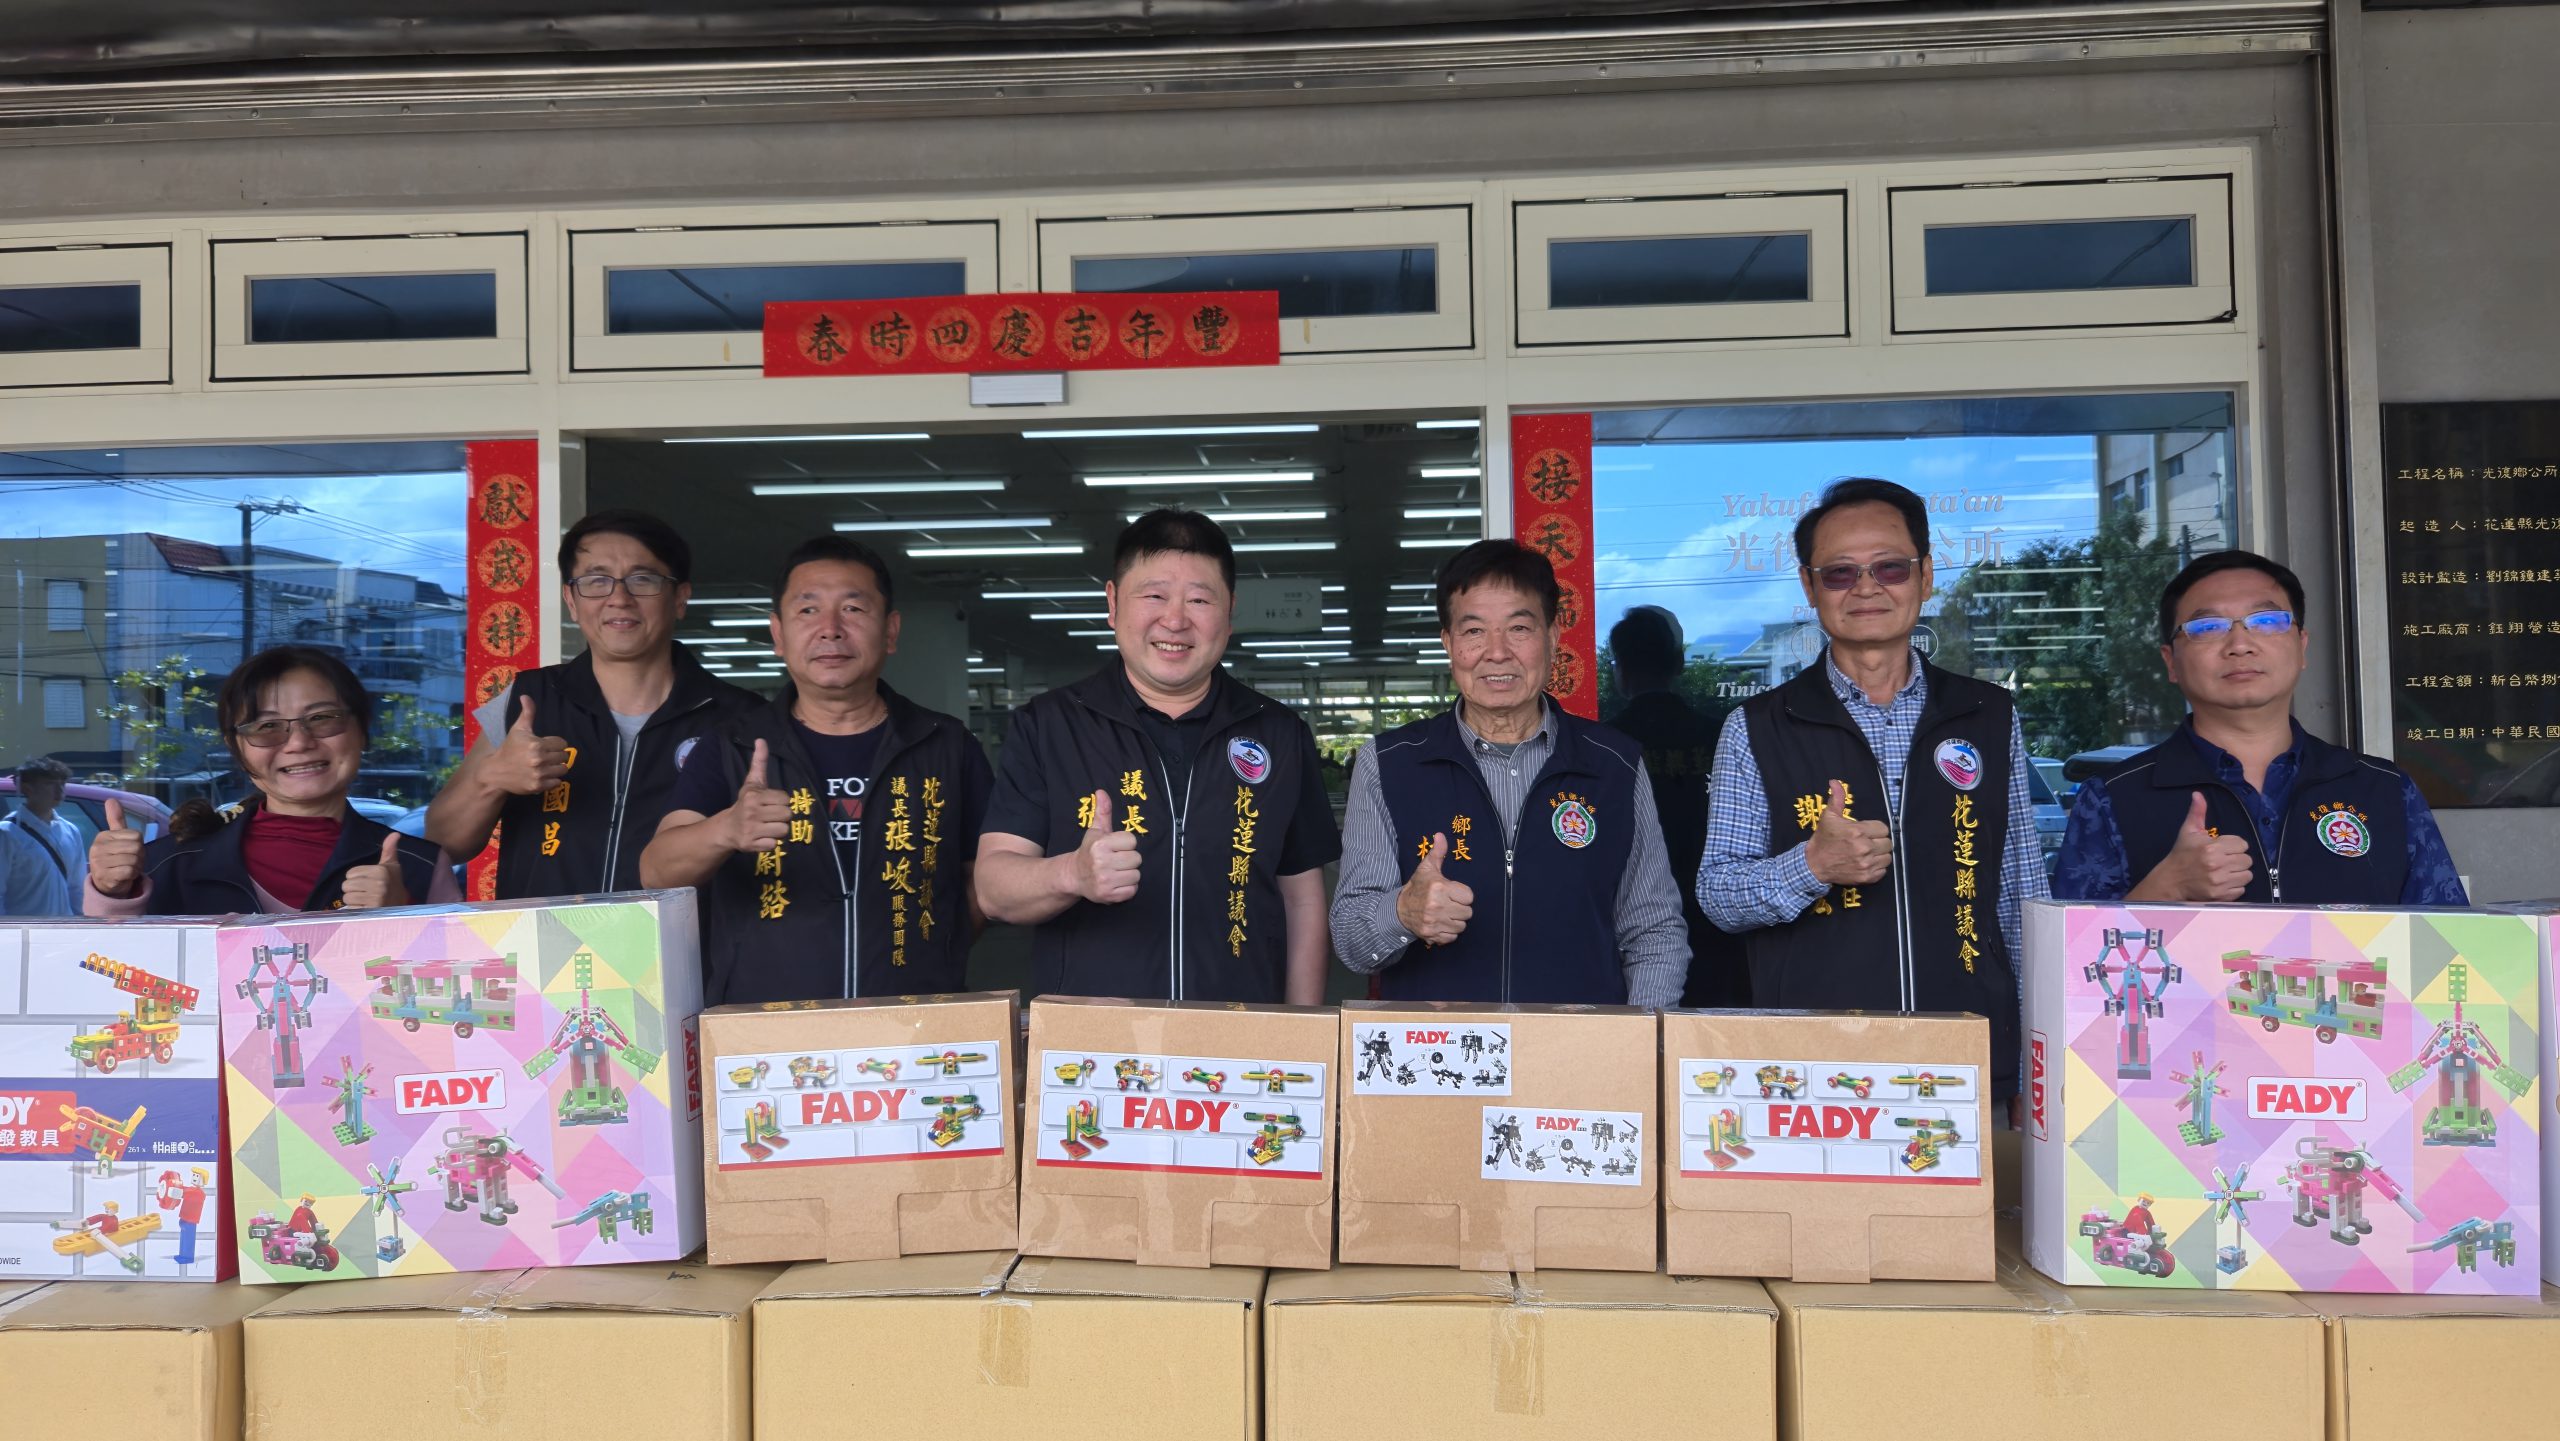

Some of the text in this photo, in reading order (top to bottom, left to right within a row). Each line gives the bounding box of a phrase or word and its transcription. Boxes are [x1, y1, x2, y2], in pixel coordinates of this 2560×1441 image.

[2398, 465, 2560, 480] 工程名稱：光復鄉公所
[2405, 673, 2560, 688] 工程金額：新台幣捌
[826, 777, 870, 796] FO
[1119, 769, 1149, 834] 議長
[789, 787, 816, 845] 特助
[1451, 814, 1473, 862] 鄉長
[1228, 785, 1260, 958] 花蓮縣議會
[1951, 793, 1981, 975] 花蓮縣議會
[1406, 1031, 1449, 1044] FADY
[403, 1076, 495, 1108] FADY
[2031, 1039, 2045, 1132] FADY
[2255, 1083, 2357, 1115] FADY
[802, 1088, 908, 1125] FADY
[1123, 1096, 1232, 1133] FADY
[1536, 1116, 1580, 1131] FADY
[1768, 1104, 1883, 1140] FADY
